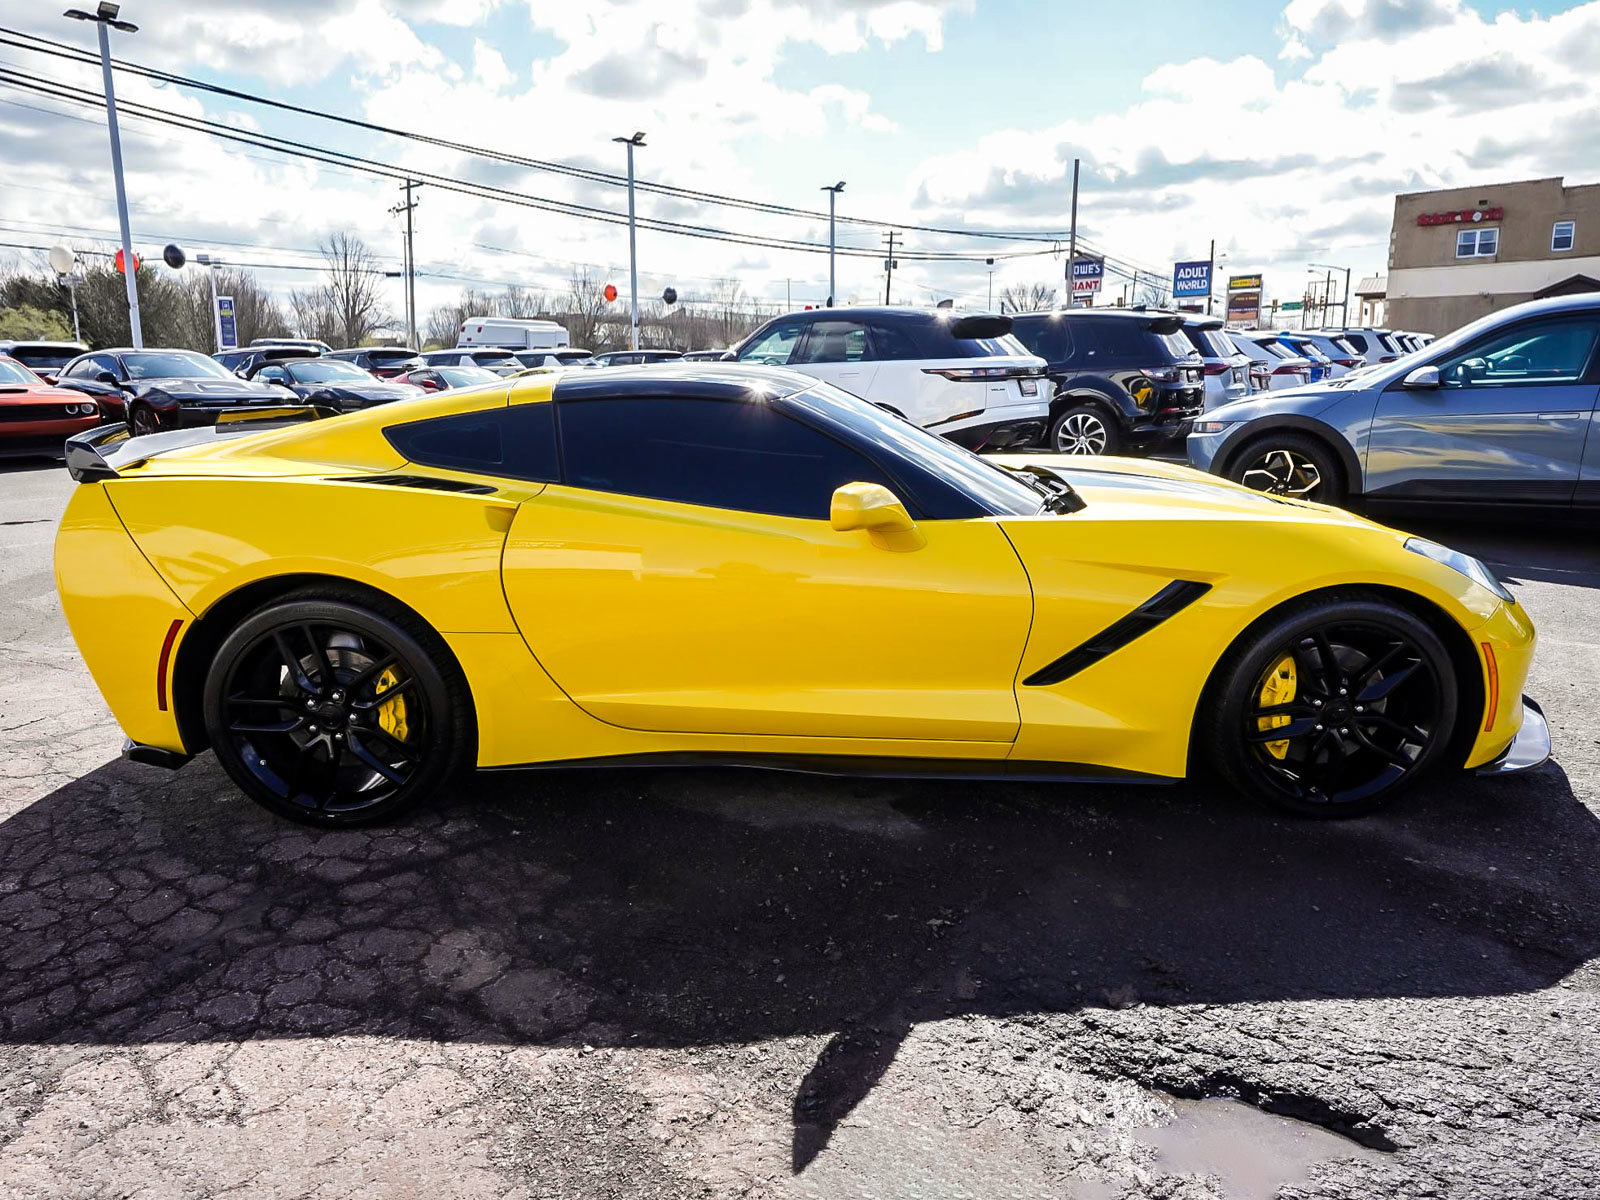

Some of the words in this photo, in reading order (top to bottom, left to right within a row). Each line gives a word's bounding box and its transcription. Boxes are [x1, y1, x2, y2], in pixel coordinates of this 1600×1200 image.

[1073, 263, 1101, 275] OWE'S
[1178, 266, 1208, 280] ADULT
[1072, 280, 1099, 291] IANT
[1177, 280, 1208, 291] WORLD
